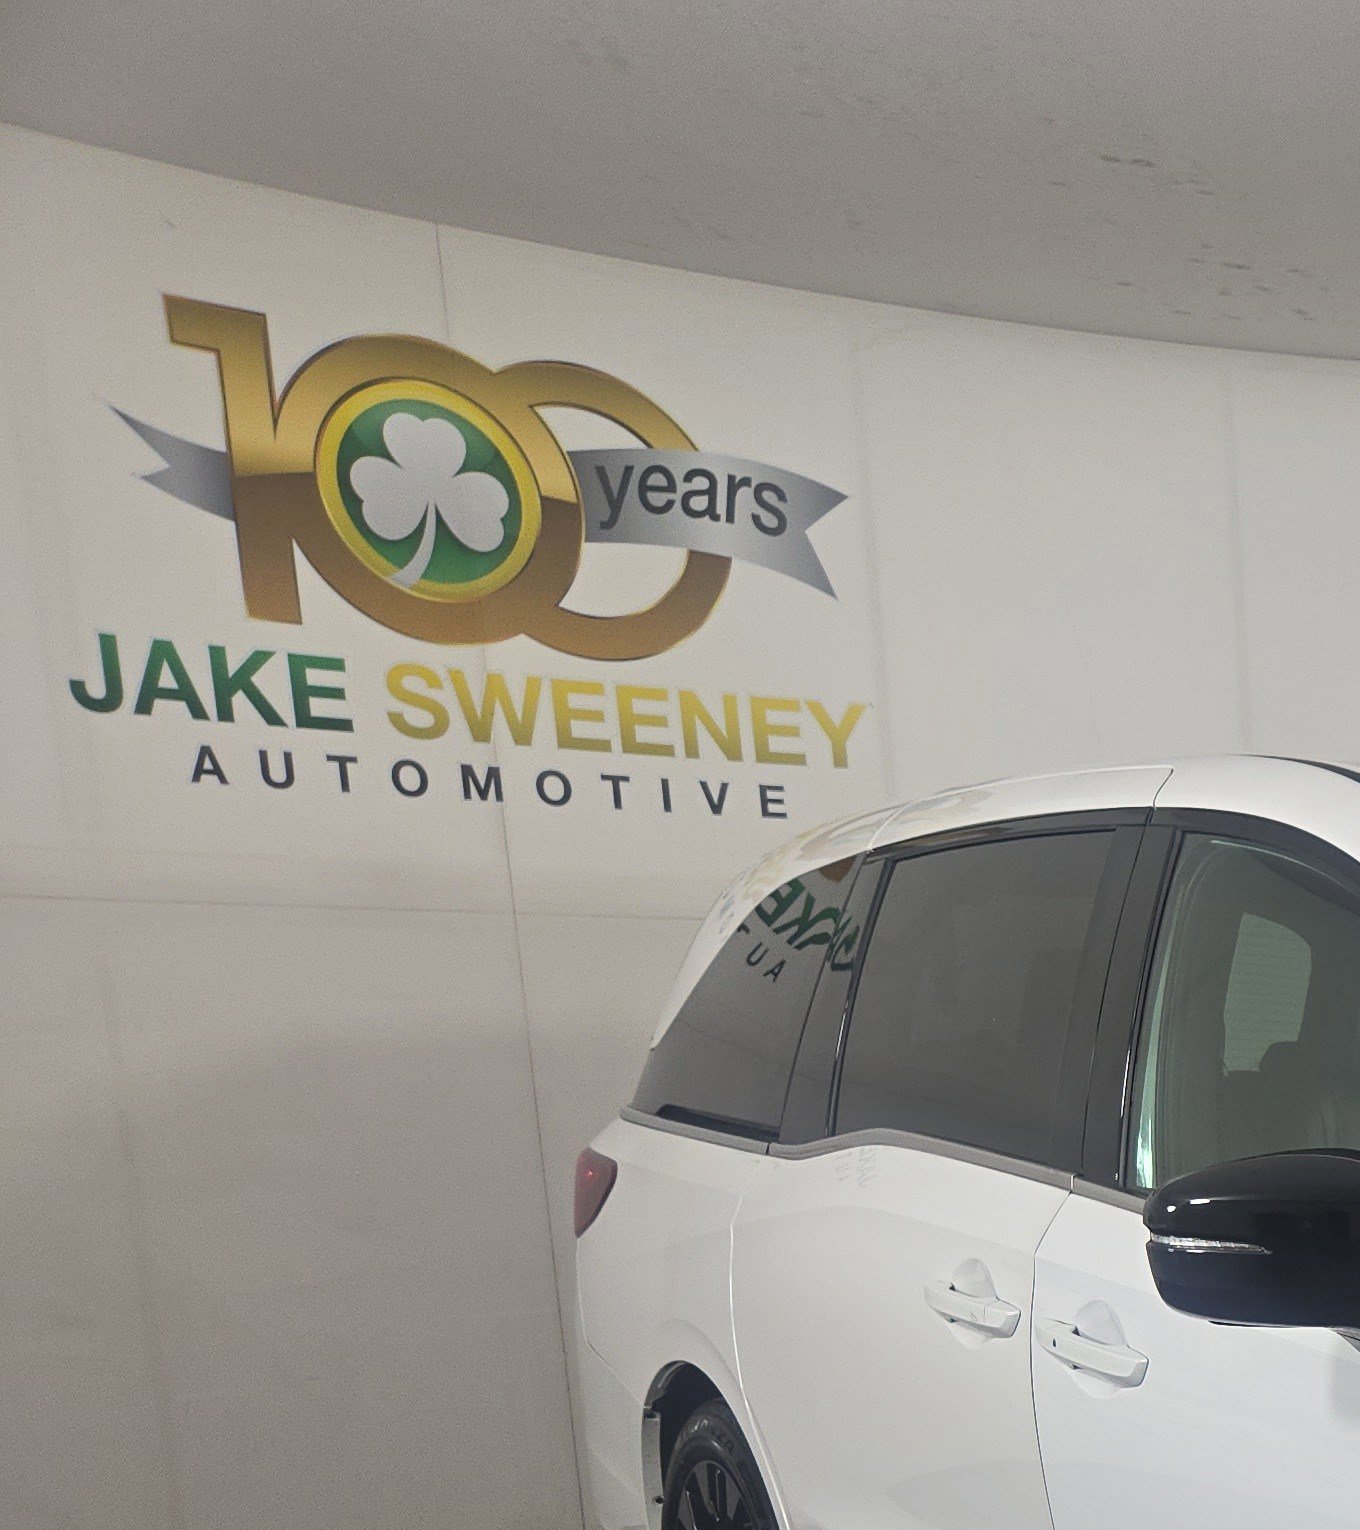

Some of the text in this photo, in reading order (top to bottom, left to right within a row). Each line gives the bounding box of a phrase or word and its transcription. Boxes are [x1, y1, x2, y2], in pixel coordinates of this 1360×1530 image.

[162, 293, 789, 660] 100 years
[69, 632, 866, 770] JAKE SWEENEY
[191, 745, 788, 819] AUTOMOTIVE
